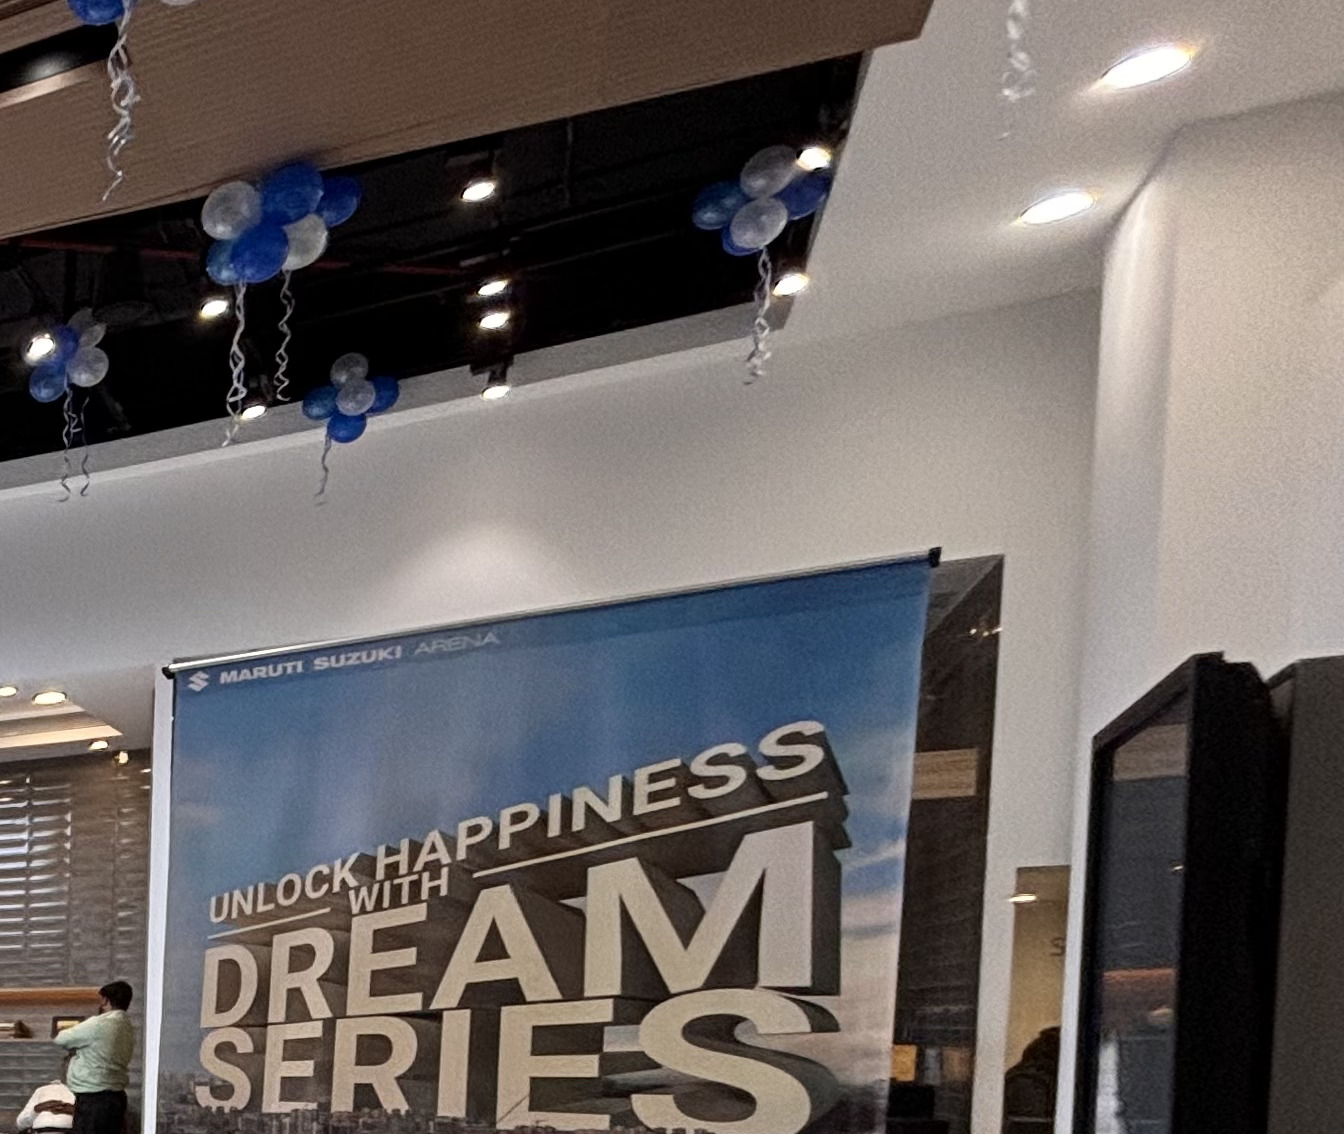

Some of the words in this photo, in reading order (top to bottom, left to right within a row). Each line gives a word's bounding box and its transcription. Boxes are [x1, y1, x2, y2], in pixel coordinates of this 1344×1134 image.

[219, 660, 303, 685] MARUTI
[313, 645, 402, 671] SUZUKI
[413, 632, 500, 656] ARENA
[209, 852, 361, 924] UNLOCK
[375, 720, 824, 881] HAPPINESS
[200, 820, 814, 1029] DREAM
[348, 866, 449, 915] WITH
